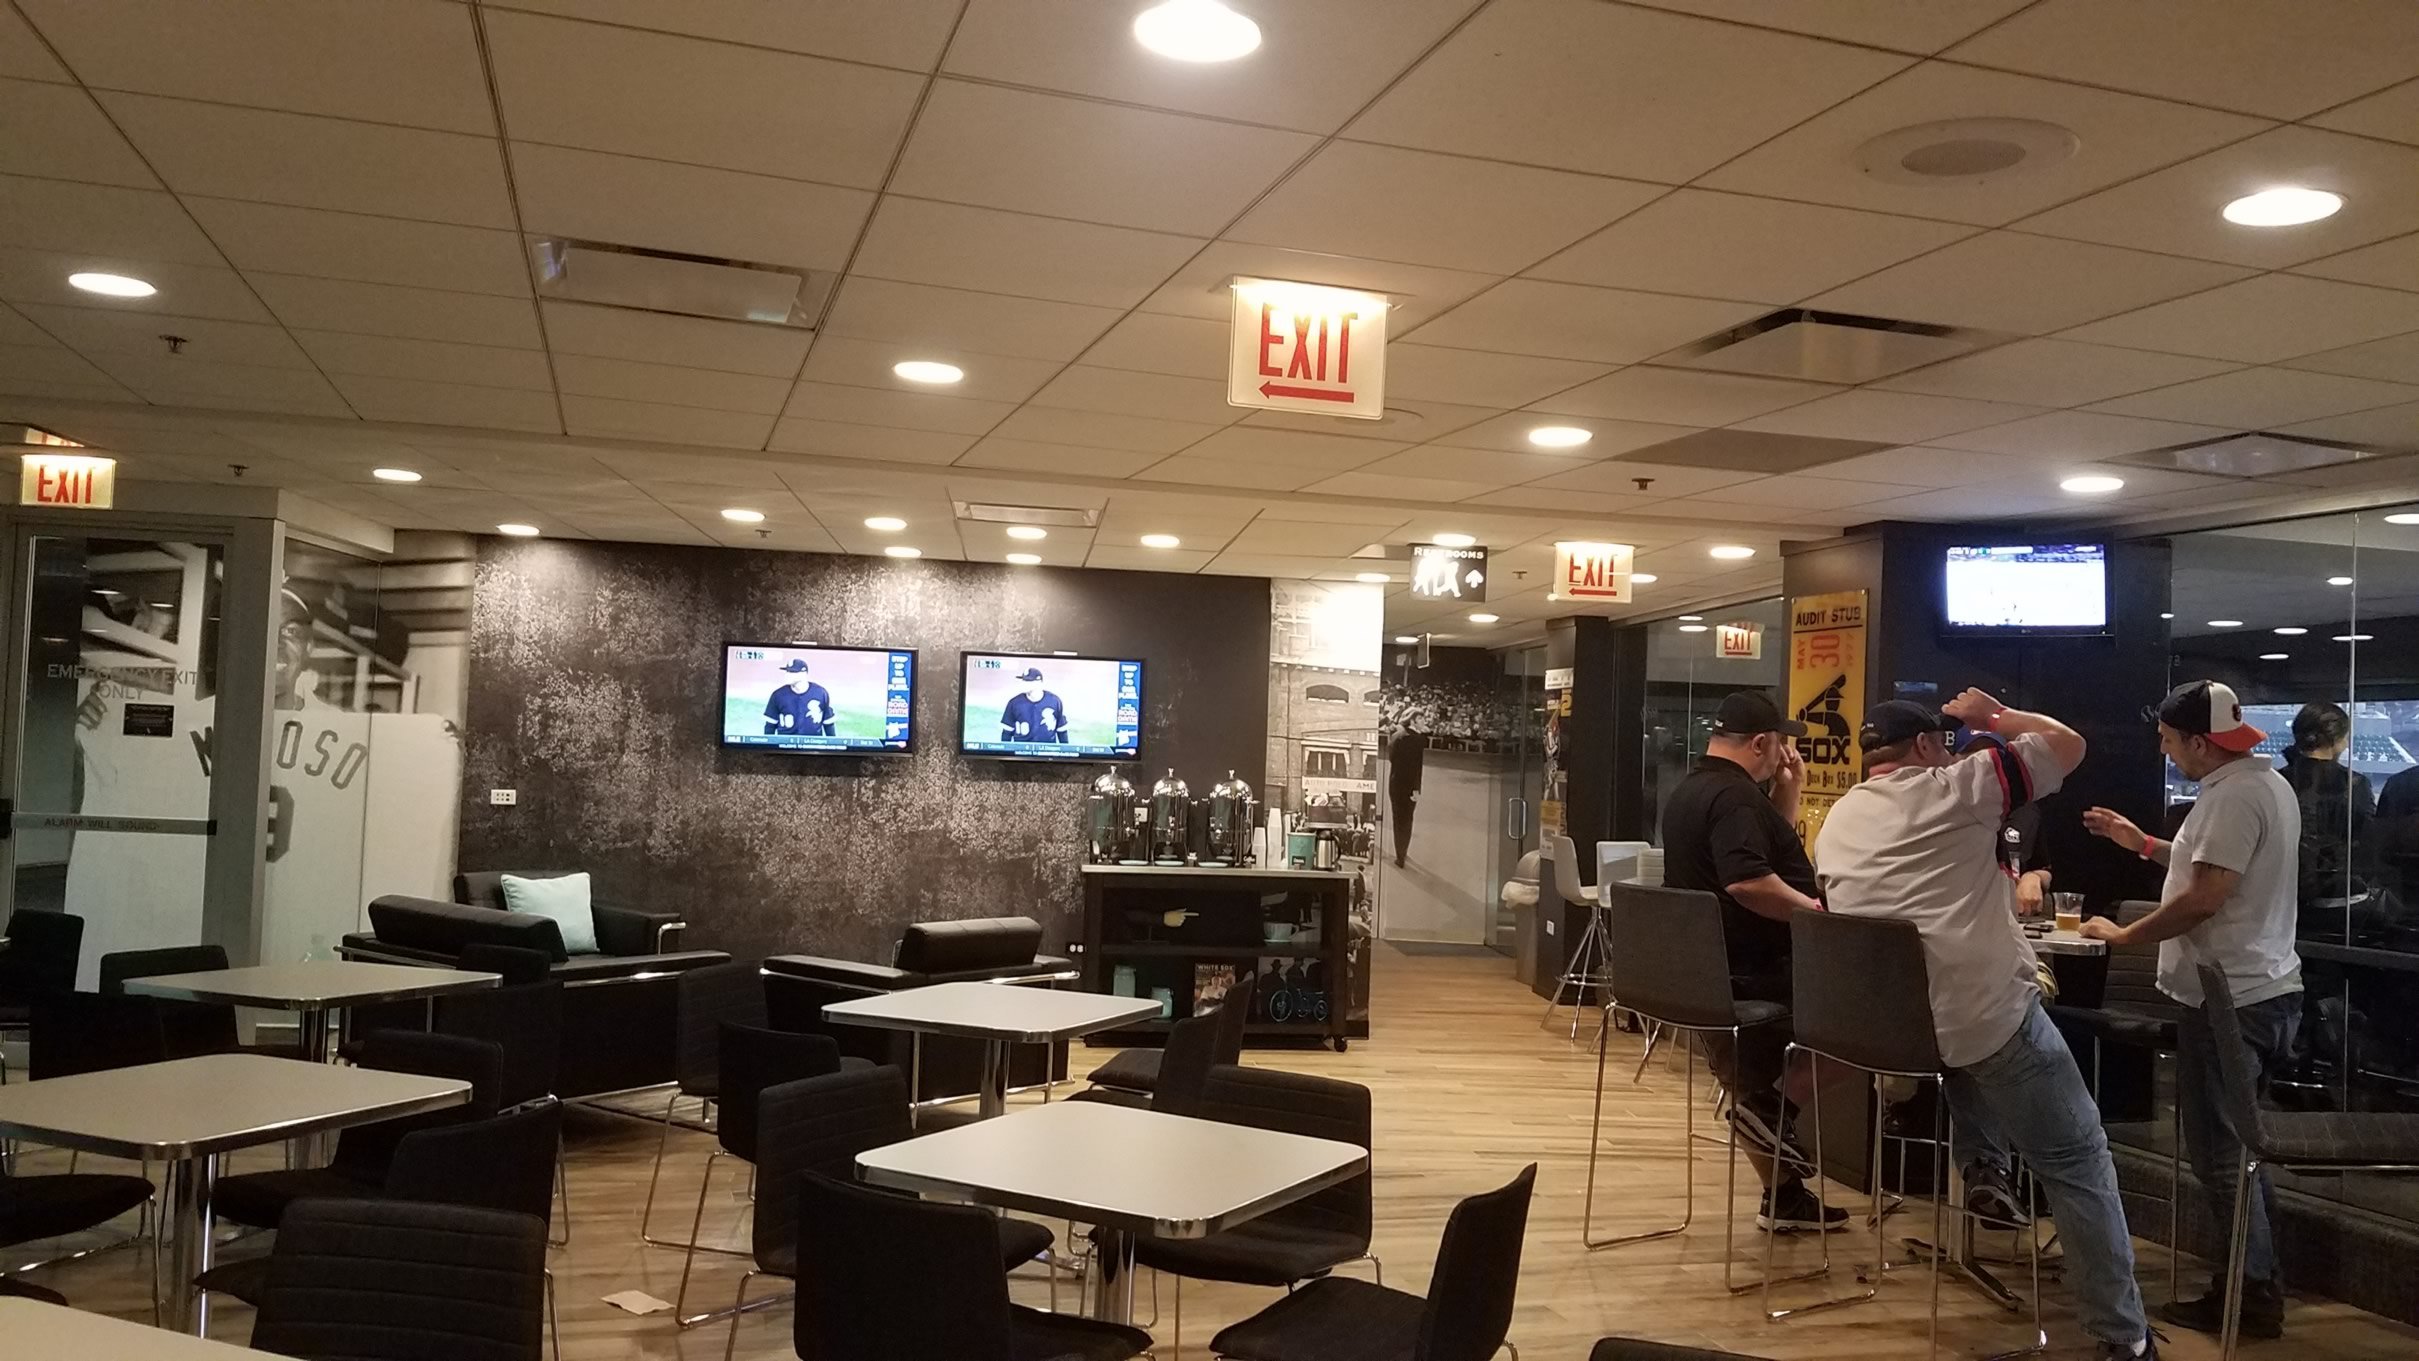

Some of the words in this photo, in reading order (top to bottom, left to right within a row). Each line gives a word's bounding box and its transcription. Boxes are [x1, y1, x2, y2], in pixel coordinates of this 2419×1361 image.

[1258, 302, 1359, 384] EXIT
[37, 463, 95, 505] EXIT
[1413, 547, 1484, 560] REROOMS
[1568, 552, 1619, 588] EXIT
[1796, 610, 1827, 626] AUDIT
[1831, 606, 1861, 623] STUB
[1724, 630, 1751, 651] EXIT
[1809, 634, 1840, 668] 30
[1796, 639, 1806, 670] MAY
[47, 664, 159, 681] EMERGENCY
[162, 670, 198, 685] EXIT
[101, 685, 143, 700] ONLY
[1944, 731, 1956, 746] B
[1796, 737, 1851, 765] SOX
[1806, 796, 1820, 806] NOT
[44, 817, 82, 827] ALARM
[88, 819, 111, 829] WILL
